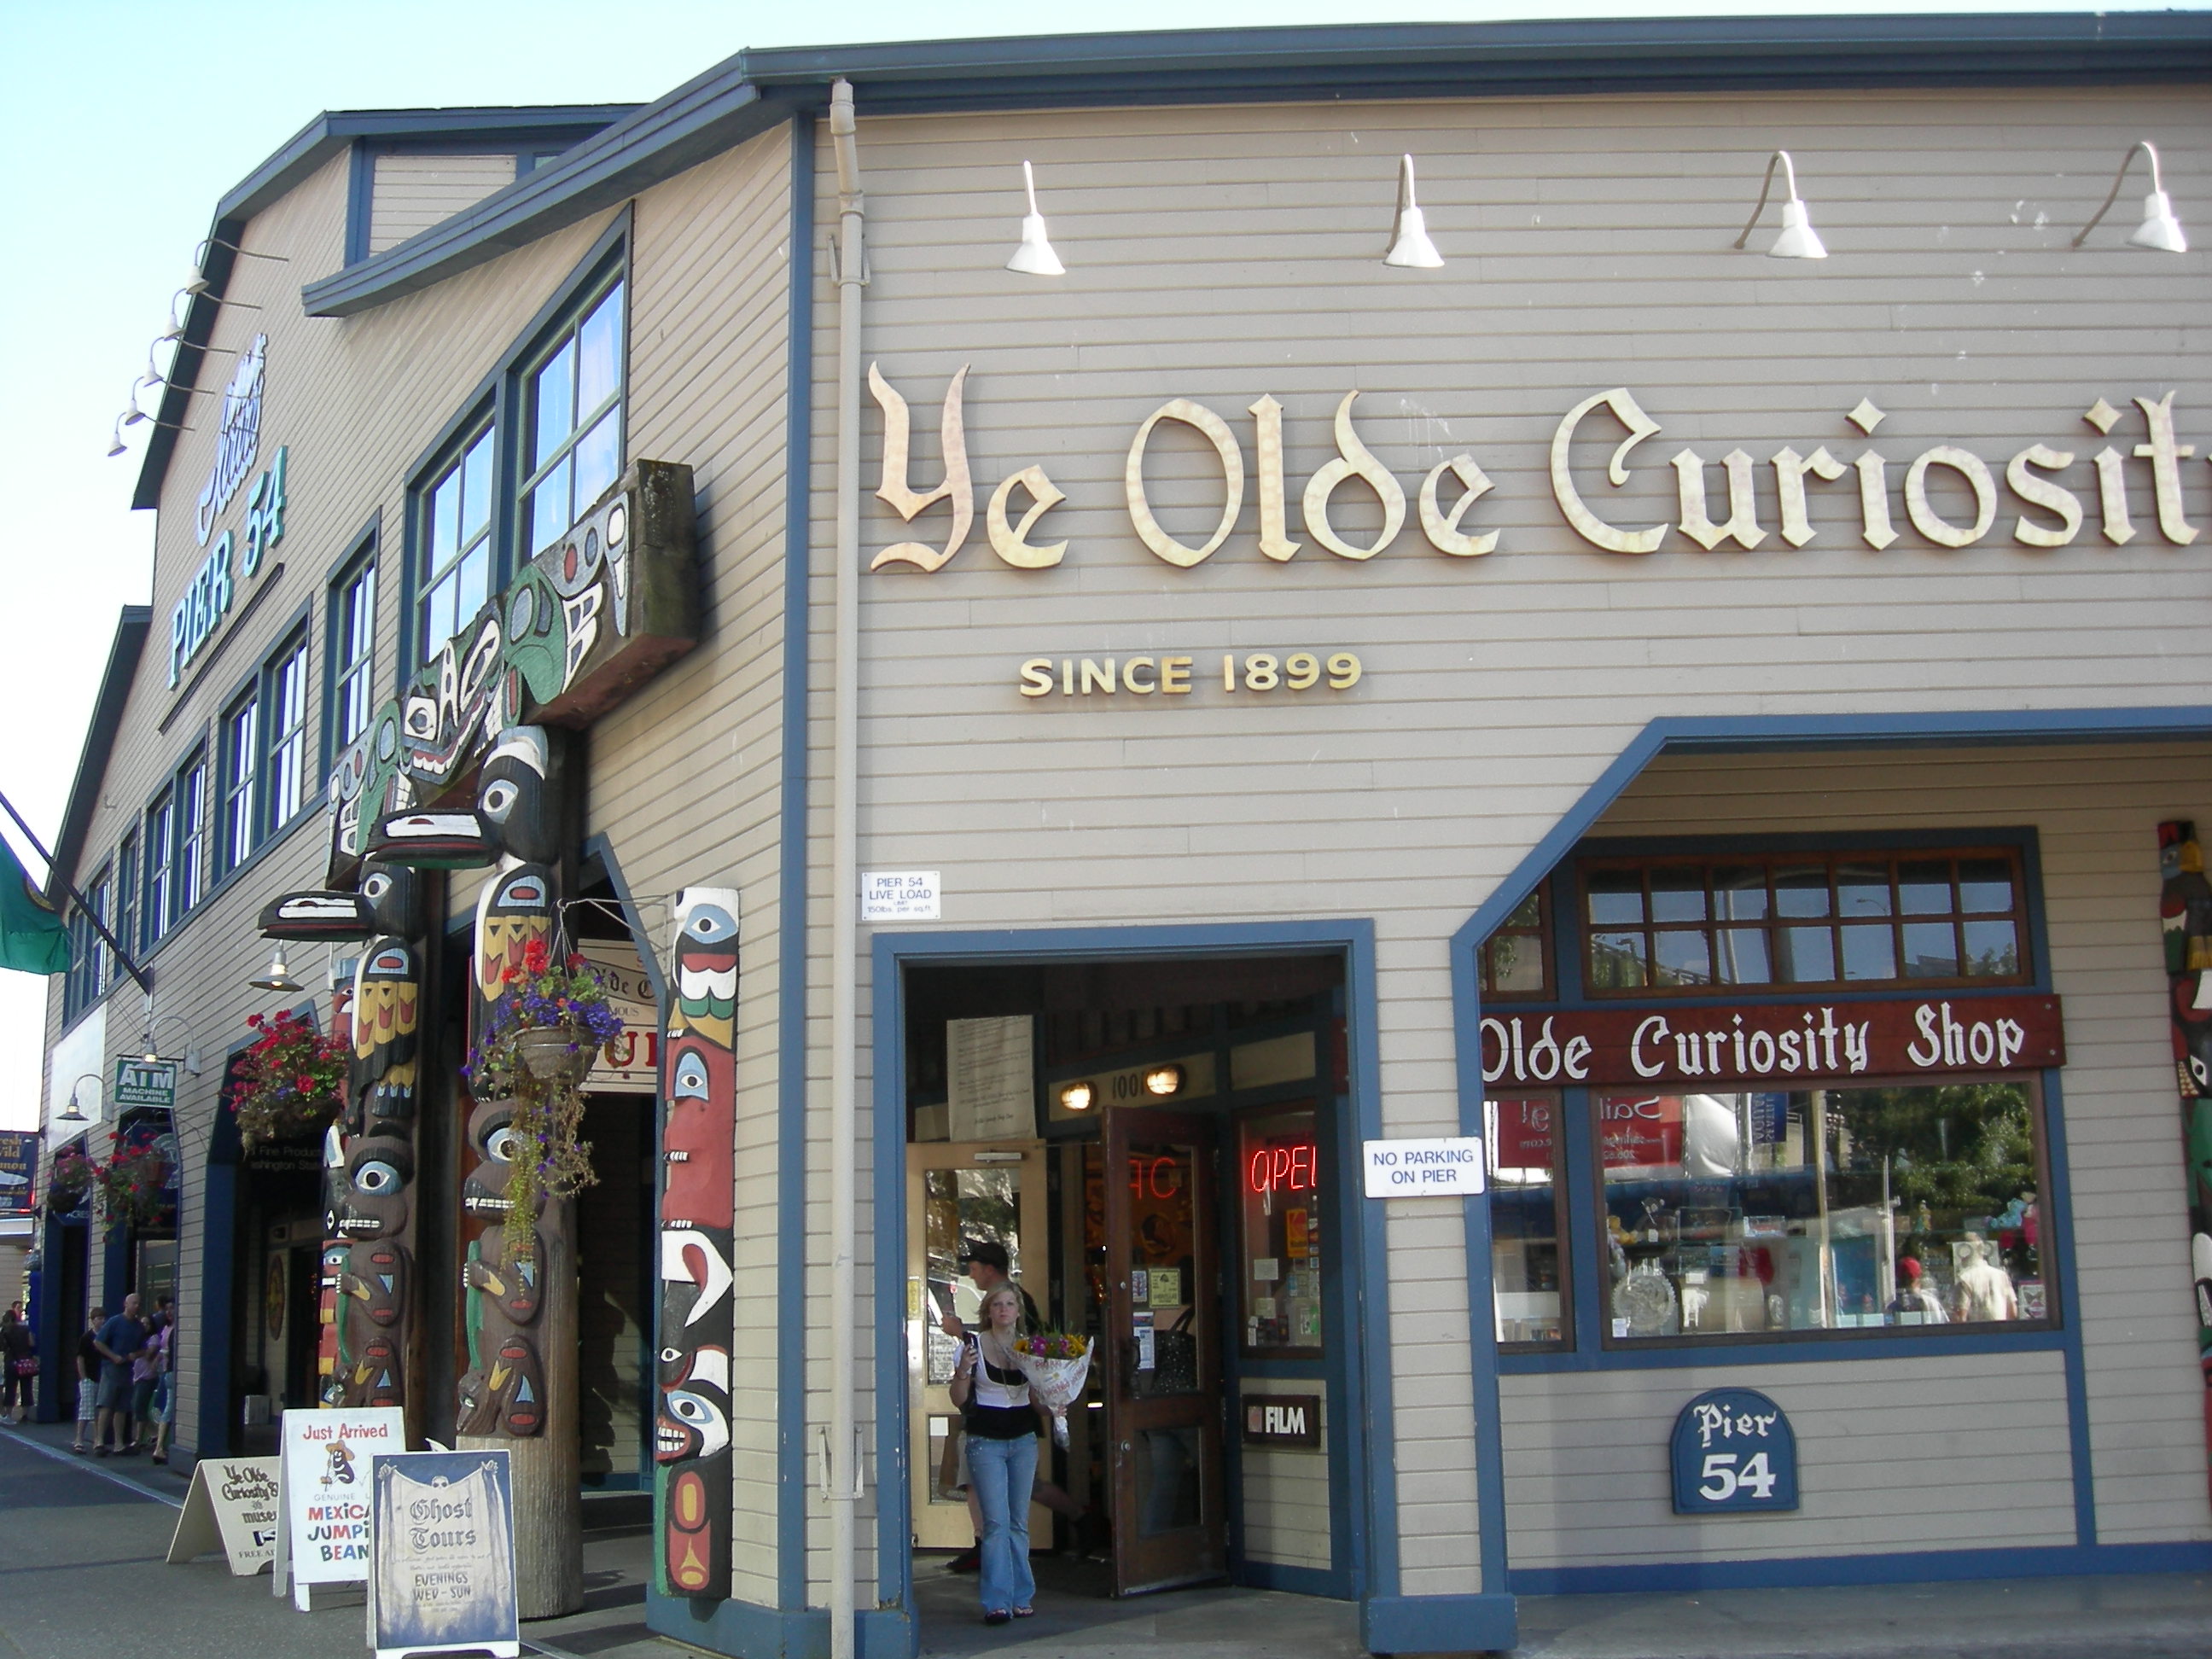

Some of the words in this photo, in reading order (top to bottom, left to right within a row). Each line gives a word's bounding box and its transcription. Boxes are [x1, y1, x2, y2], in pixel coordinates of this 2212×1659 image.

[870, 361, 1069, 573] Ye
[1126, 390, 1500, 568] Olde
[1550, 387, 2212, 554] Curiosit
[168, 529, 234, 691] PIER
[242, 445, 288, 578] 54
[1020, 656, 1193, 698] SINCE
[1224, 652, 1363, 693] 1899
[877, 877, 902, 887] PIER
[908, 876, 923, 887] 54
[870, 890, 894, 899] LIVE
[899, 889, 932, 899] LOAD
[1630, 1007, 1870, 1078] Curiosity
[1907, 1001, 2026, 1067] Shop
[119, 1094, 171, 1103] AVAILABLE
[123, 1087, 169, 1097] MACHINE
[0, 1145, 20, 1158] ild
[1373, 1151, 1397, 1166] NO
[1405, 1150, 1474, 1165] PARKING
[1391, 1170, 1415, 1185] ON
[1422, 1169, 1457, 1183] PIER
[1265, 1406, 1306, 1435] FILM
[1693, 1402, 1778, 1448] Pier
[303, 1425, 334, 1441] Just
[338, 1423, 388, 1441] Arrived
[224, 1464, 245, 1485] Ye
[242, 1466, 270, 1483] Olde
[1698, 1452, 1777, 1501] 54
[222, 1483, 270, 1501] Curiosity
[314, 1493, 356, 1502] GENUINE
[410, 1497, 472, 1525] Ghost
[409, 1527, 476, 1554] Tours
[239, 1551, 261, 1559] FREE
[415, 1572, 469, 1586] EVENINGS
[413, 1586, 439, 1601] WED
[451, 1585, 471, 1598] SUN
